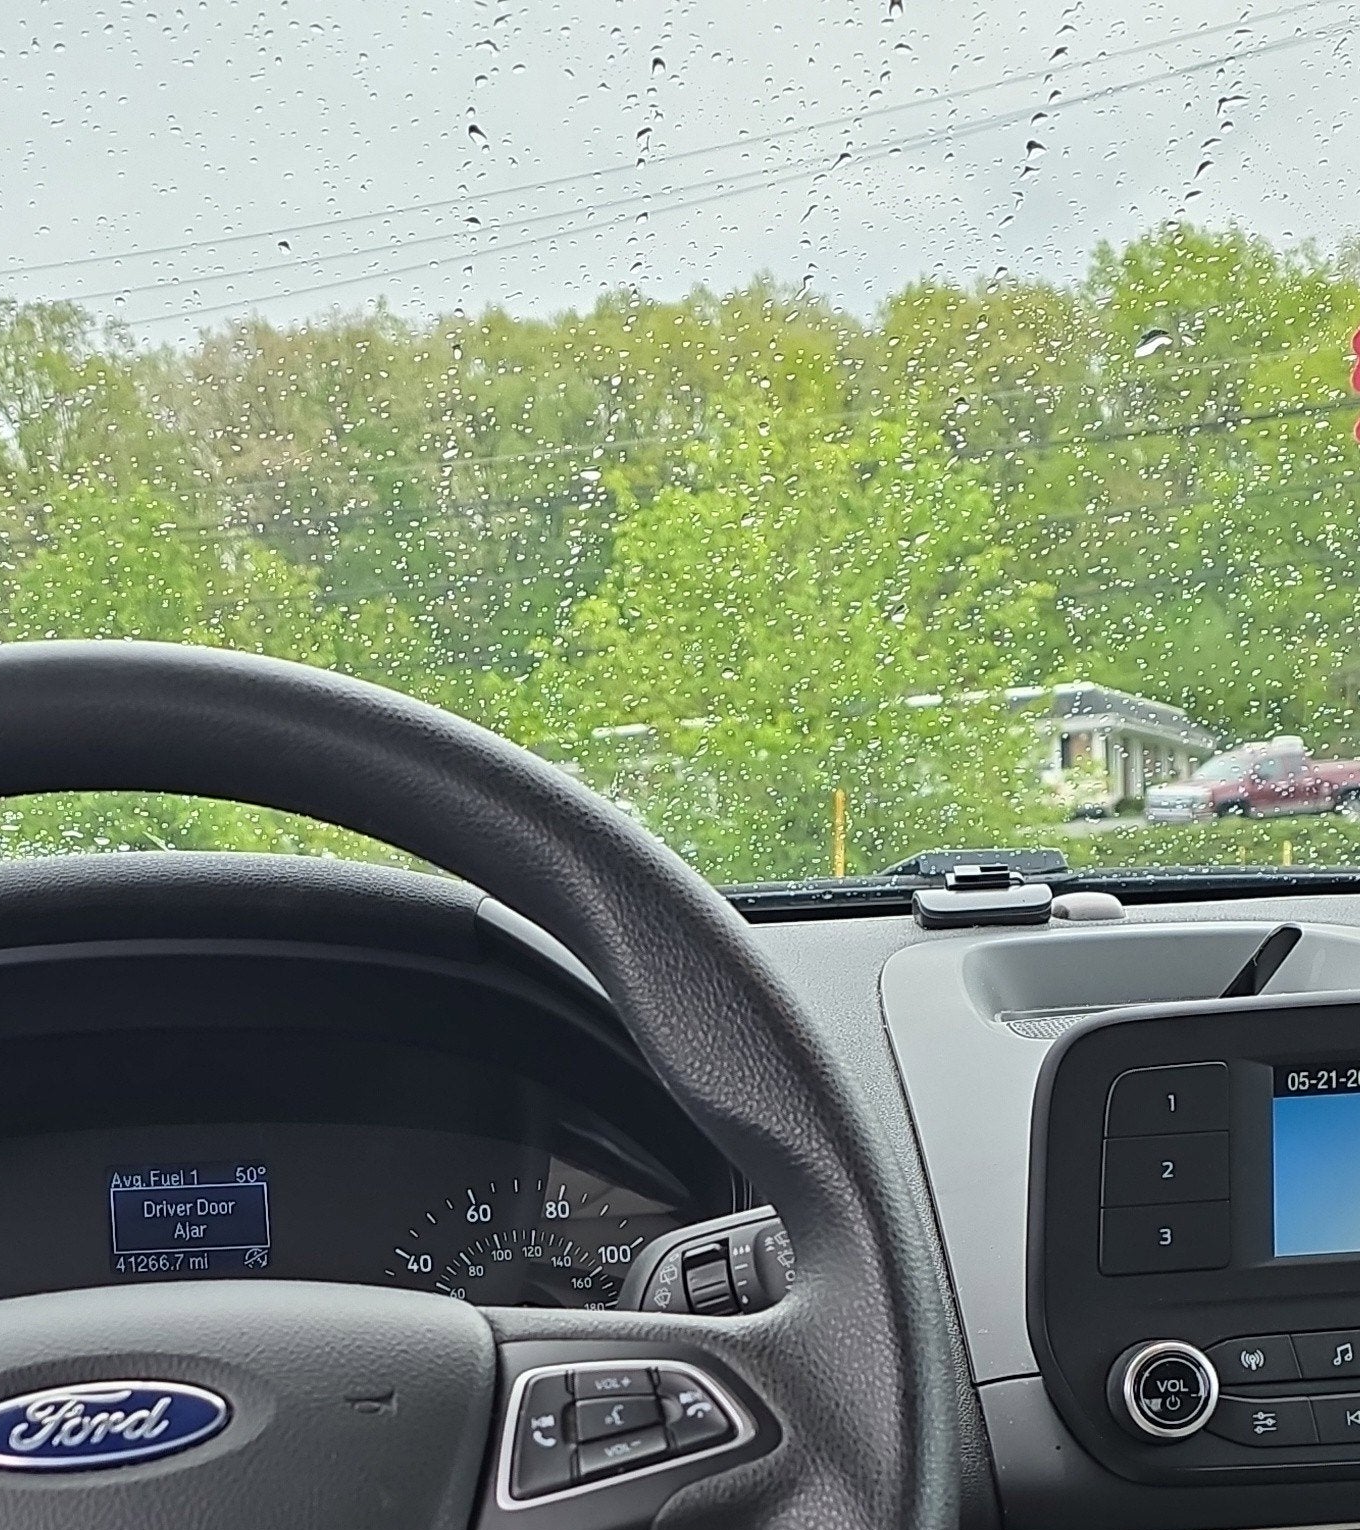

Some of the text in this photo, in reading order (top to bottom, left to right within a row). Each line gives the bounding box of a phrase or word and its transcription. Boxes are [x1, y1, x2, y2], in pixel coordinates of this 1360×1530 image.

[1167, 1094, 1176, 1112] 1
[111, 1171, 147, 1189] Avg.
[150, 1169, 184, 1187] Fuel
[190, 1169, 199, 1185] 1
[1161, 1161, 1174, 1179] 2
[143, 1198, 236, 1218] Driver Door
[466, 1204, 491, 1223] 60
[545, 1200, 570, 1220] 80
[174, 1221, 208, 1241] Ajar
[1159, 1228, 1172, 1245] 3
[490, 1247, 513, 1261] 100
[521, 1244, 542, 1258] 120
[597, 1245, 631, 1264] 100
[116, 1253, 209, 1274] 41266.7 mi
[406, 1254, 432, 1273] 40
[550, 1254, 572, 1268] 140
[468, 1264, 484, 1278] 80
[570, 1276, 592, 1290] 160
[449, 1287, 466, 1301] 60
[584, 1301, 605, 1312] 180
[1156, 1378, 1190, 1394] VOL
[8, 1389, 173, 1451] Ford
